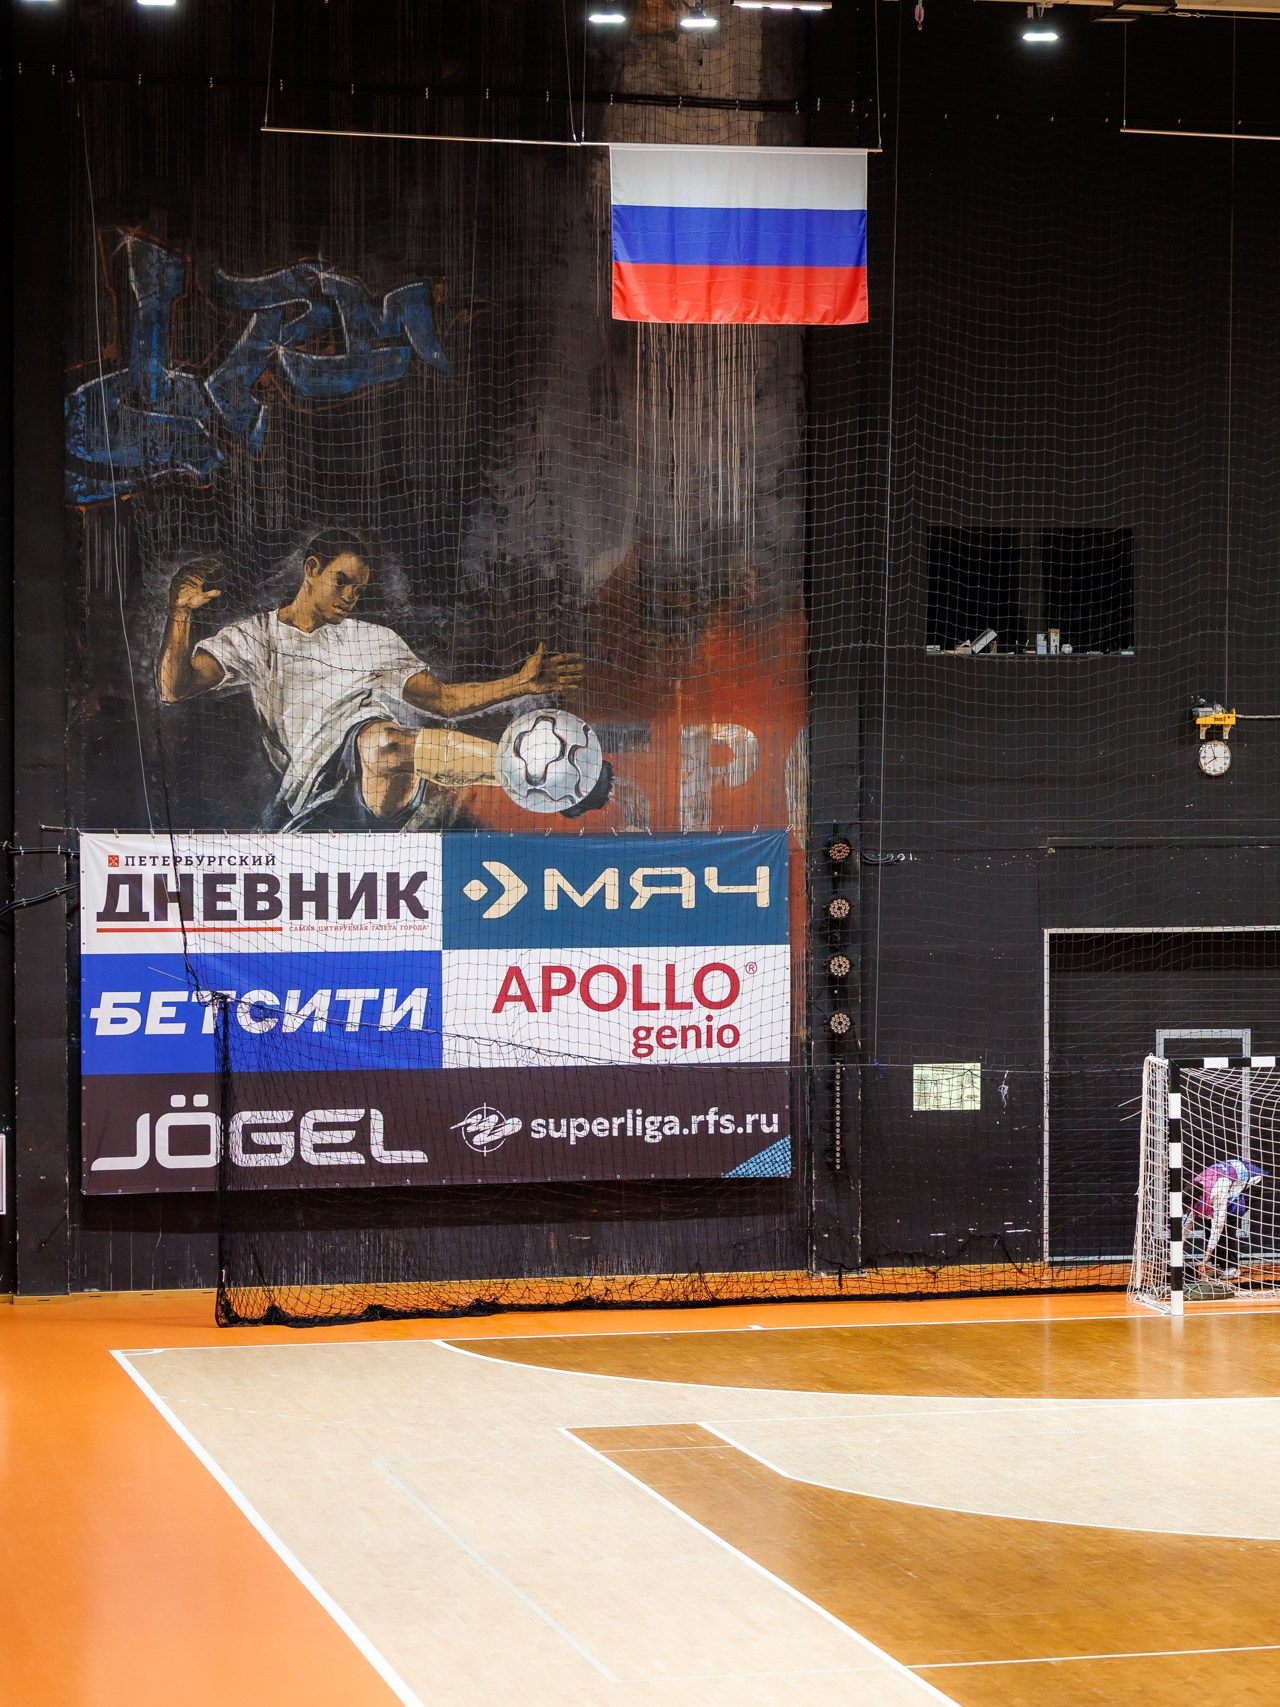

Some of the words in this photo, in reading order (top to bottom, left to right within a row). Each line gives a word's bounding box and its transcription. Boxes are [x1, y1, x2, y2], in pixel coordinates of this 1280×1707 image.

[124, 854, 276, 867] ПЕТЕРБУРГСКИЙ
[96, 871, 429, 922] ДНЕВНИК
[544, 865, 770, 911] МЯЧ
[89, 987, 429, 1036] БЕТСИТИ
[631, 1014, 741, 1058] genio
[90, 1093, 429, 1171] JÖGEL
[530, 1107, 779, 1145] superliga.rfs.ru
